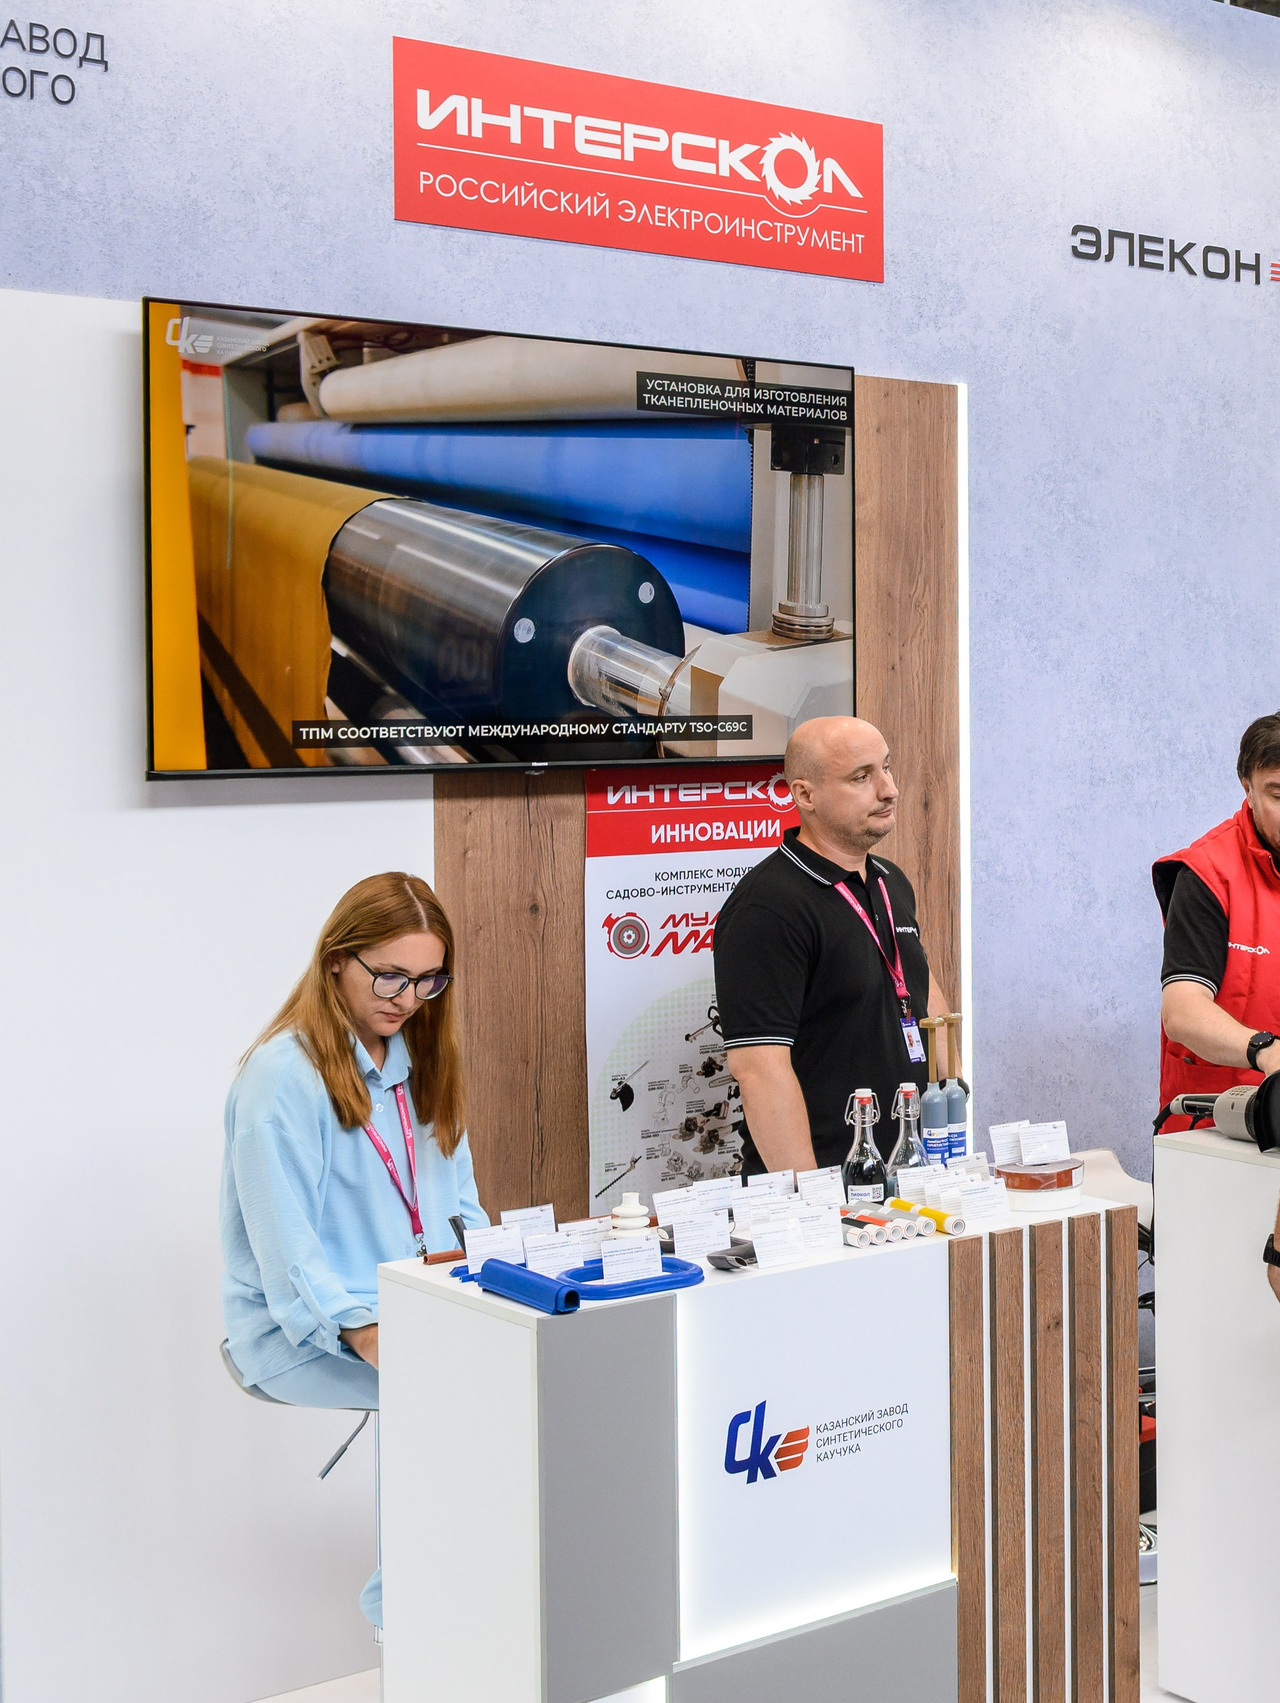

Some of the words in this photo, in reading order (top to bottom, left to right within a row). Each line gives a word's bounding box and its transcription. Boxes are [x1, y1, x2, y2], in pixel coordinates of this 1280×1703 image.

[0, 19, 109, 72] АВОД
[0, 66, 76, 105] ОГО
[416, 88, 864, 206] ИНТЕРСКОЛ
[420, 171, 609, 219] РОССИЙСКИЙ
[618, 199, 865, 254] ЭЛЕКТРОИНСТРУМЕНТ
[1071, 224, 1261, 285] ЭЛЕКОН
[643, 394, 764, 414] ТКАНЕПЛЕНОЧНЫХ
[767, 405, 848, 421] МАТЕРИАЛОВ
[646, 379, 721, 395] УСТАНОВКА
[724, 387, 750, 399] ДЛЯ
[754, 390, 847, 407] ИЗГОТОВЛЕНИЯ
[300, 727, 333, 740] ТПМ
[337, 725, 465, 739] СООТВЕТСТВУЮТ
[468, 723, 608, 738] МЕЖДУНАРОДНОМУ
[612, 722, 687, 736] СТАНДАРТУ
[689, 721, 748, 733] TSO-C69C
[607, 773, 793, 806] ИНТЕРСКО
[651, 818, 781, 844] ИННОВАЦИИ
[655, 869, 714, 882] КОМПЛЕКС
[606, 882, 737, 900] САДОВО-ИНСТРУМЕНТА
[651, 930, 715, 957] МА
[816, 1409, 875, 1434] КАЗАНСКИЙ
[877, 1403, 909, 1419] ЗАВОД
[816, 1418, 904, 1449] СИНТЕТИЧЕСКОГО
[816, 1443, 861, 1463] КАУЧУКА
